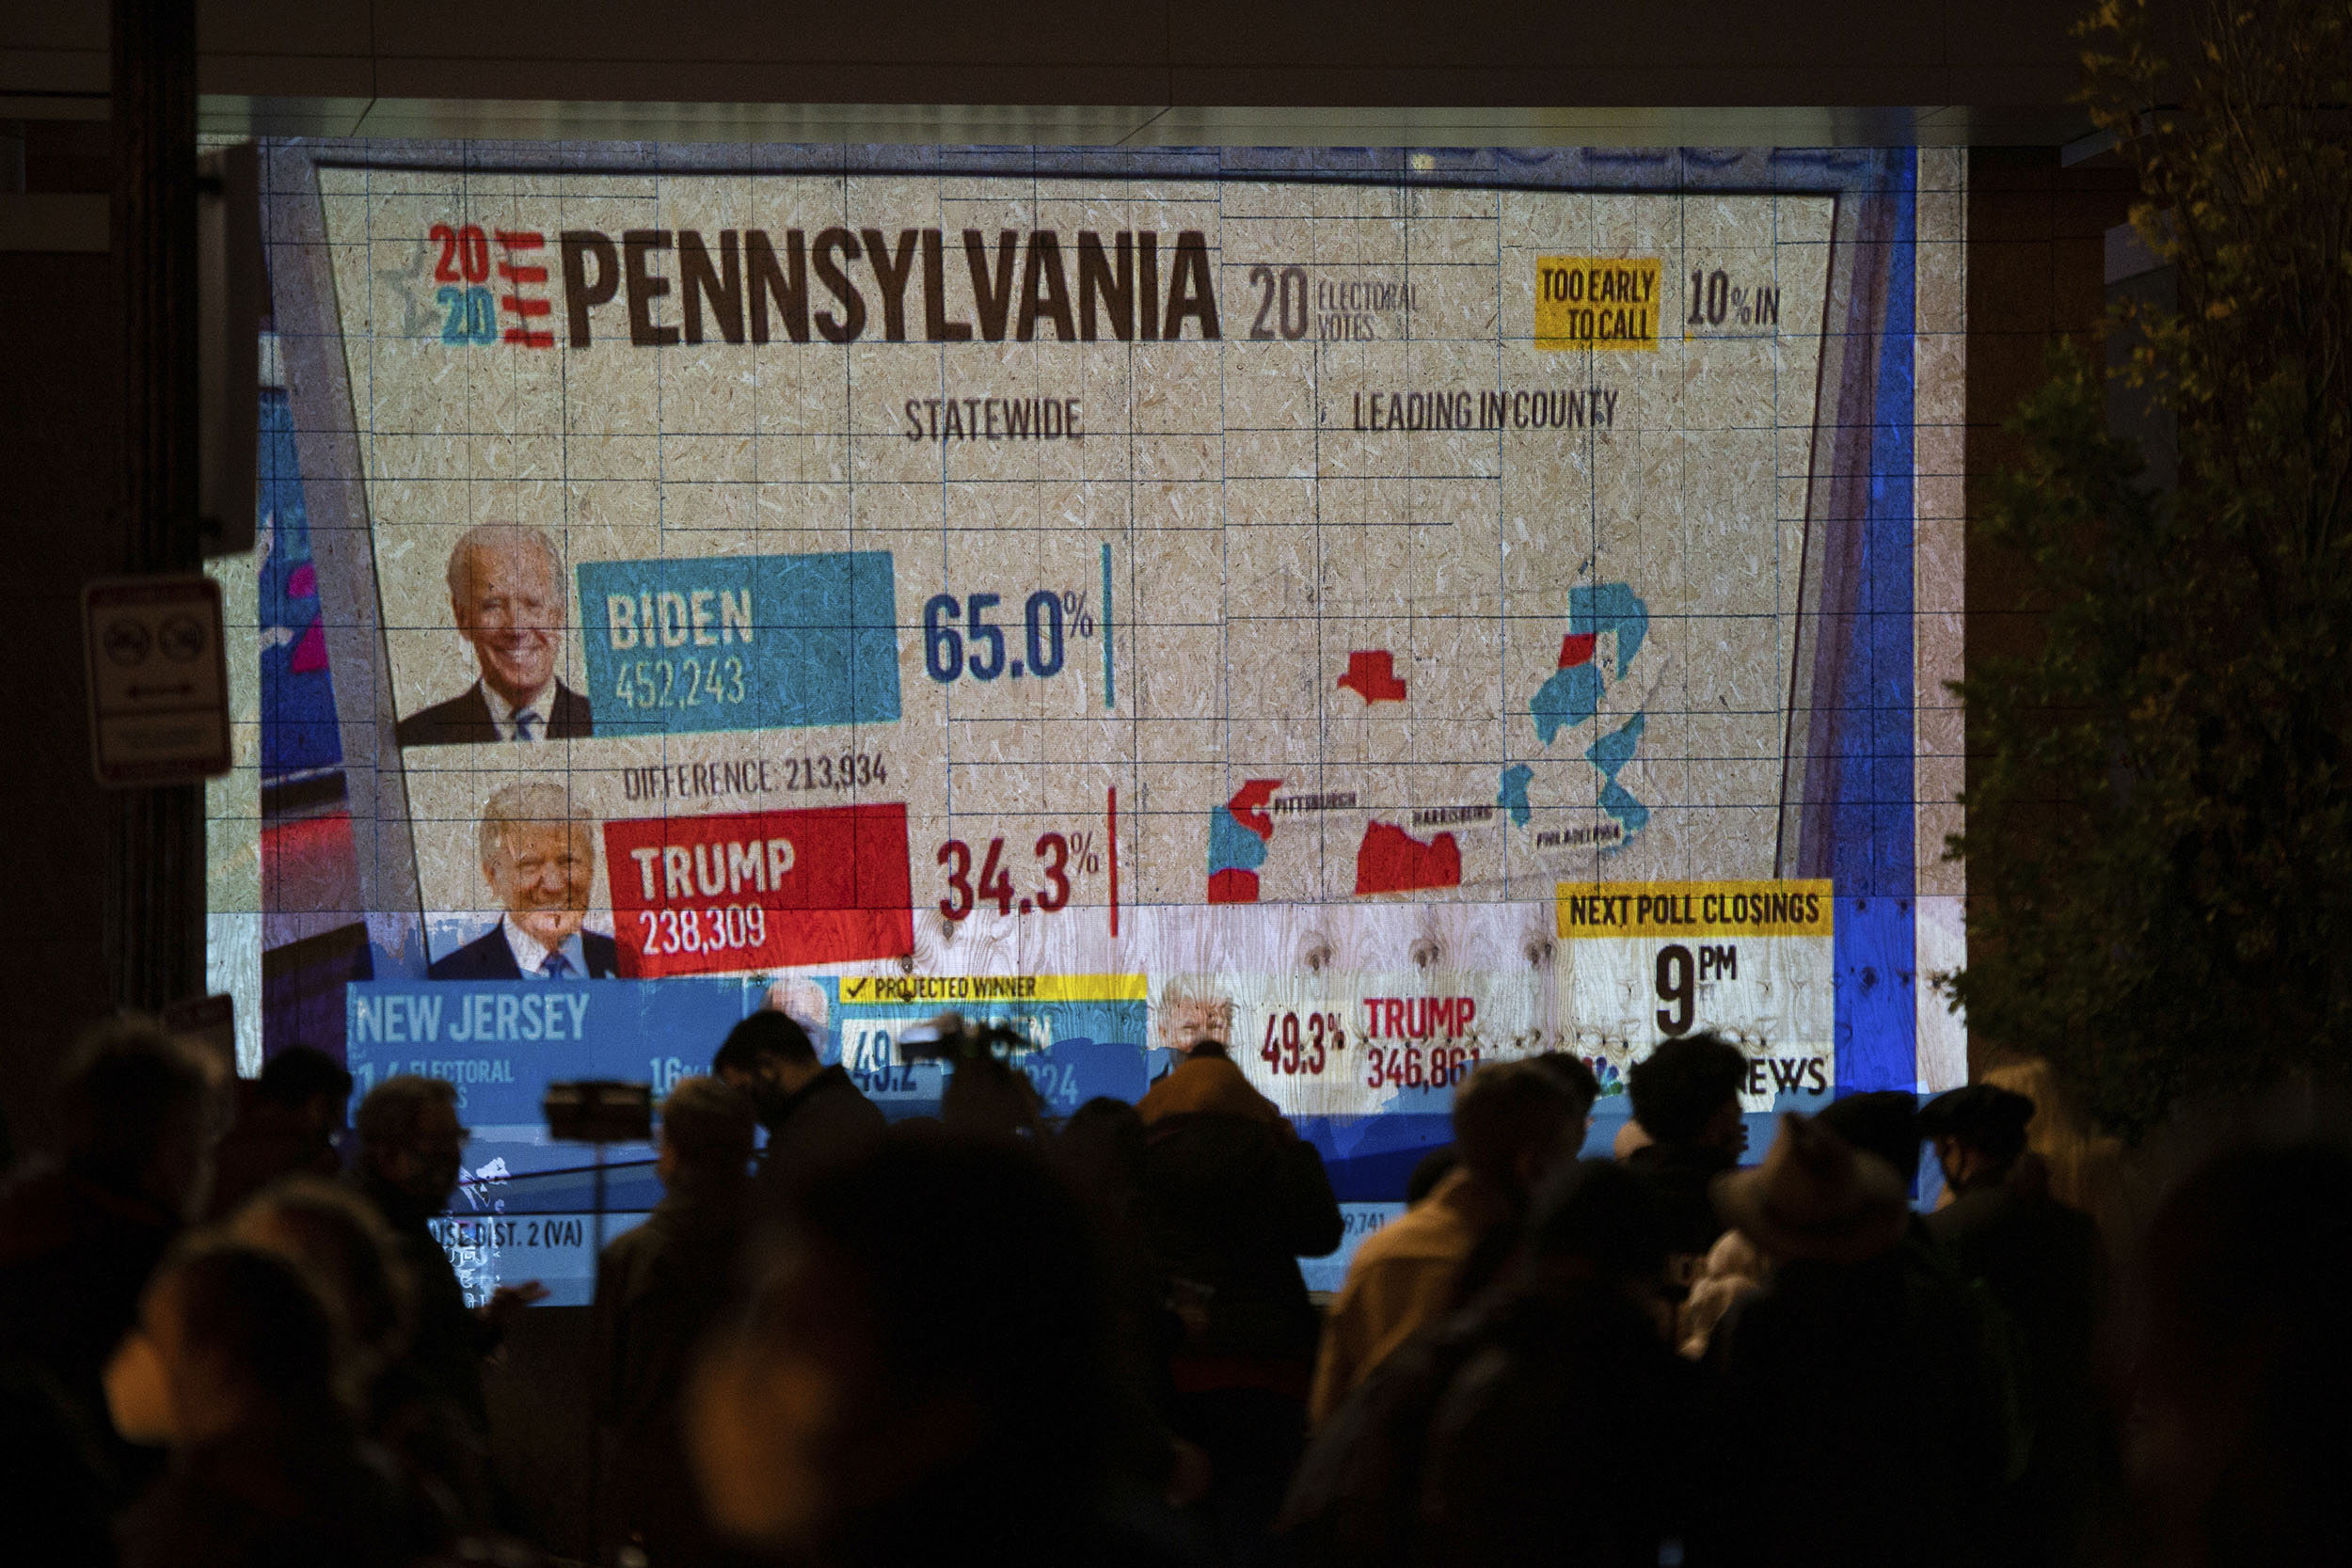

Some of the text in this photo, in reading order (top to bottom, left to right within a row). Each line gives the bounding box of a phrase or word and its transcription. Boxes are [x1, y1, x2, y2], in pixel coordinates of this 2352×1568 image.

[430, 224, 489, 282] 20
[561, 226, 1220, 347] PENNSYLVANIA
[1249, 265, 1308, 340] 20
[1317, 280, 1422, 312] ELECTORAL
[1542, 268, 1655, 303] TOO EARLY
[1687, 268, 1781, 325] 10% IN
[437, 286, 498, 346] 20
[1317, 312, 1375, 341] VOTES
[1568, 308, 1651, 340] TO CALL
[905, 397, 1084, 442] STATEWIDE
[1353, 388, 1618, 431] LEADING IN COUNTY
[607, 589, 752, 650] BIDEN
[922, 589, 1093, 683] 65.0%
[615, 657, 746, 708] 452,243
[623, 752, 887, 802] DIFFERENCE: 213,934
[631, 838, 796, 901] TRUMP
[937, 830, 1100, 922] 34.3%
[639, 903, 767, 958] 238,309
[1570, 892, 1820, 926] NEXT POLL CLOSINGS
[875, 975, 1036, 999] PROJECTED WINNER
[1656, 943, 1738, 1036] 9 PM
[357, 992, 590, 1041] NEW JERSEY
[1364, 997, 1475, 1039] TRUMP
[1738, 1055, 1828, 1097] EWS
[527, 1222, 540, 1247] 2
[544, 1218, 583, 1249] (VA)
